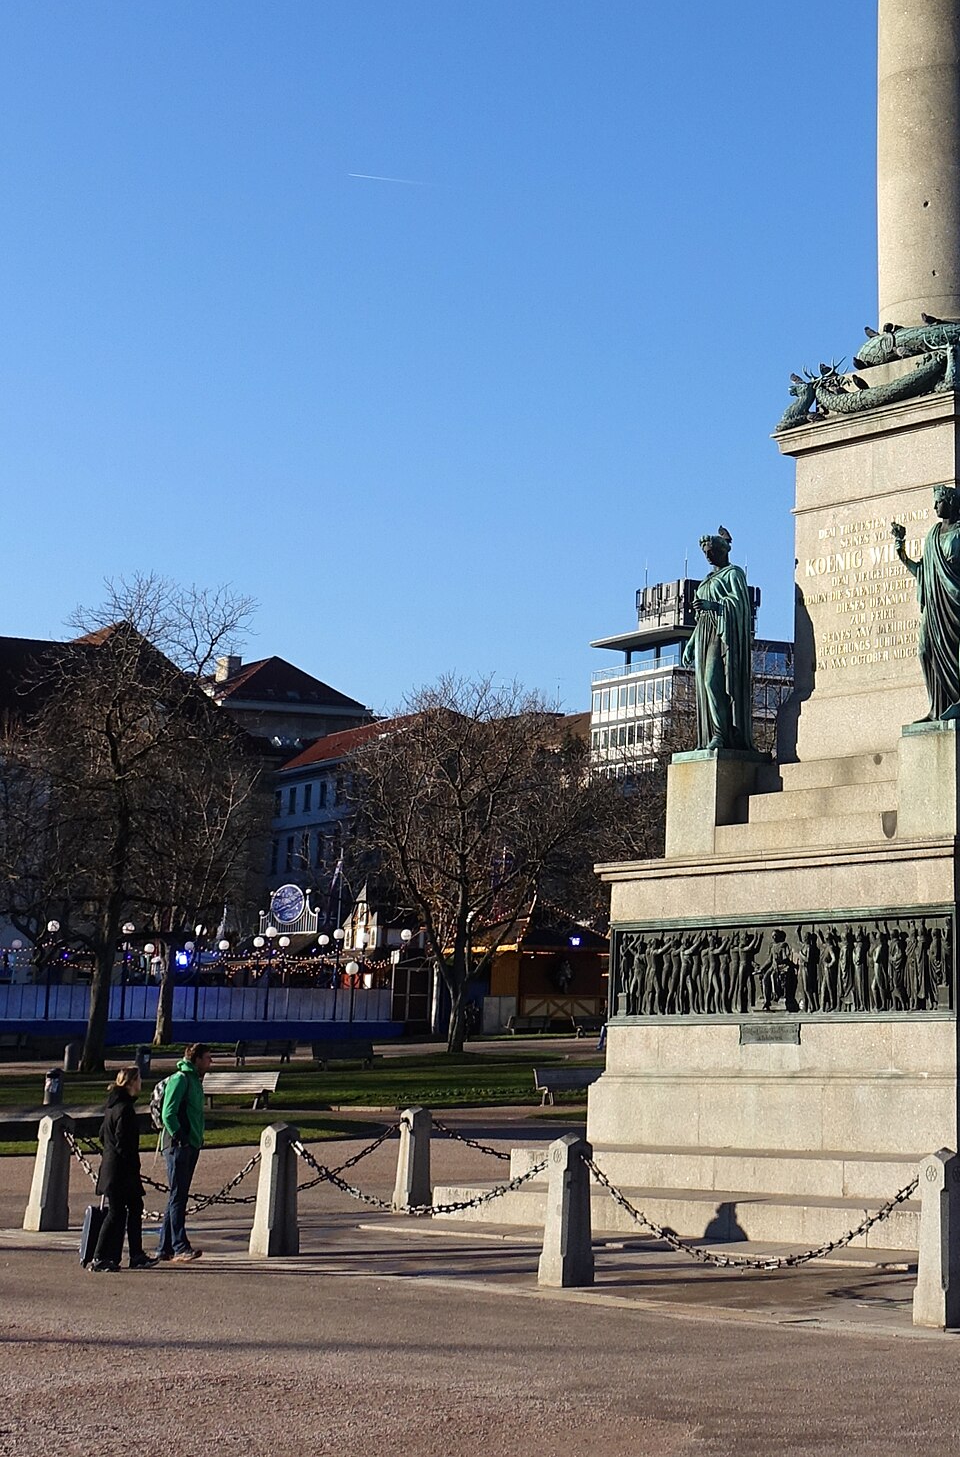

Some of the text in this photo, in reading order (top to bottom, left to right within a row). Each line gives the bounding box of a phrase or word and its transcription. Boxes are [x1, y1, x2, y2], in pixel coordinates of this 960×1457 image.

[818, 526, 836, 540] DEM
[805, 549, 863, 577] KOENIG
[831, 574, 850, 587] DEM
[830, 590, 843, 601] DIE
[836, 593, 911, 614] DIESES DENKMAL
[850, 609, 895, 625] ZUR FEIER
[821, 629, 851, 643] SEINES
[818, 640, 872, 657] REGIERUNGS
[850, 650, 889, 666] OCTOBER
